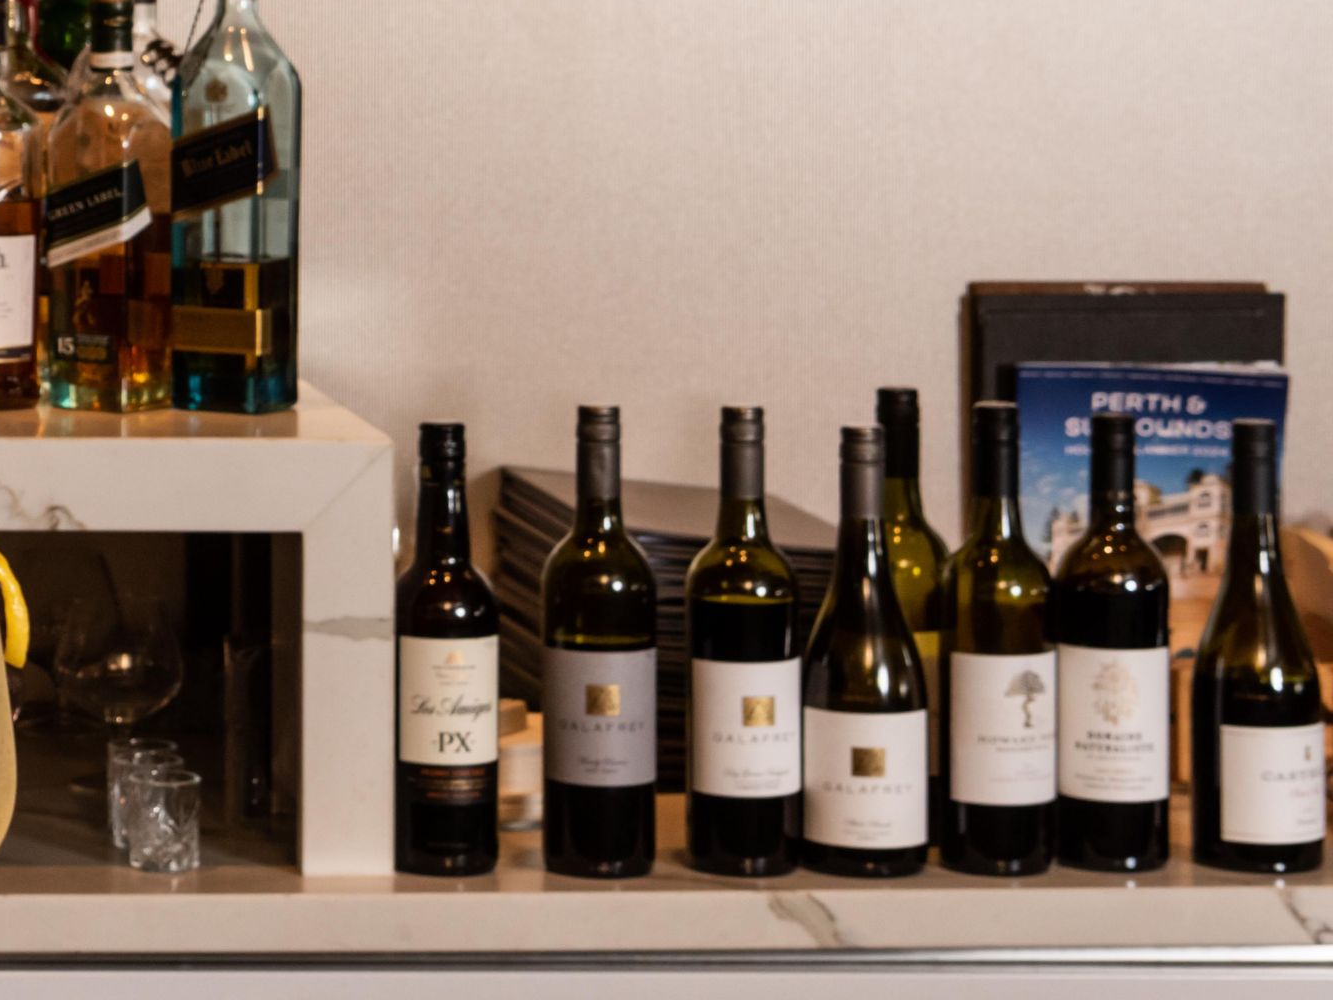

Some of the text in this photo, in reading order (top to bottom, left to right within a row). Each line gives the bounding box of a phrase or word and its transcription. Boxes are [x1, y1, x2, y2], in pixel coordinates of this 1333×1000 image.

[47, 186, 126, 223] GREEN LABEL
[57, 336, 76, 355] 15
[1090, 390, 1208, 415] PERTH &
[1063, 416, 1233, 440] SUOUNDS
[437, 731, 471, 753] PX
